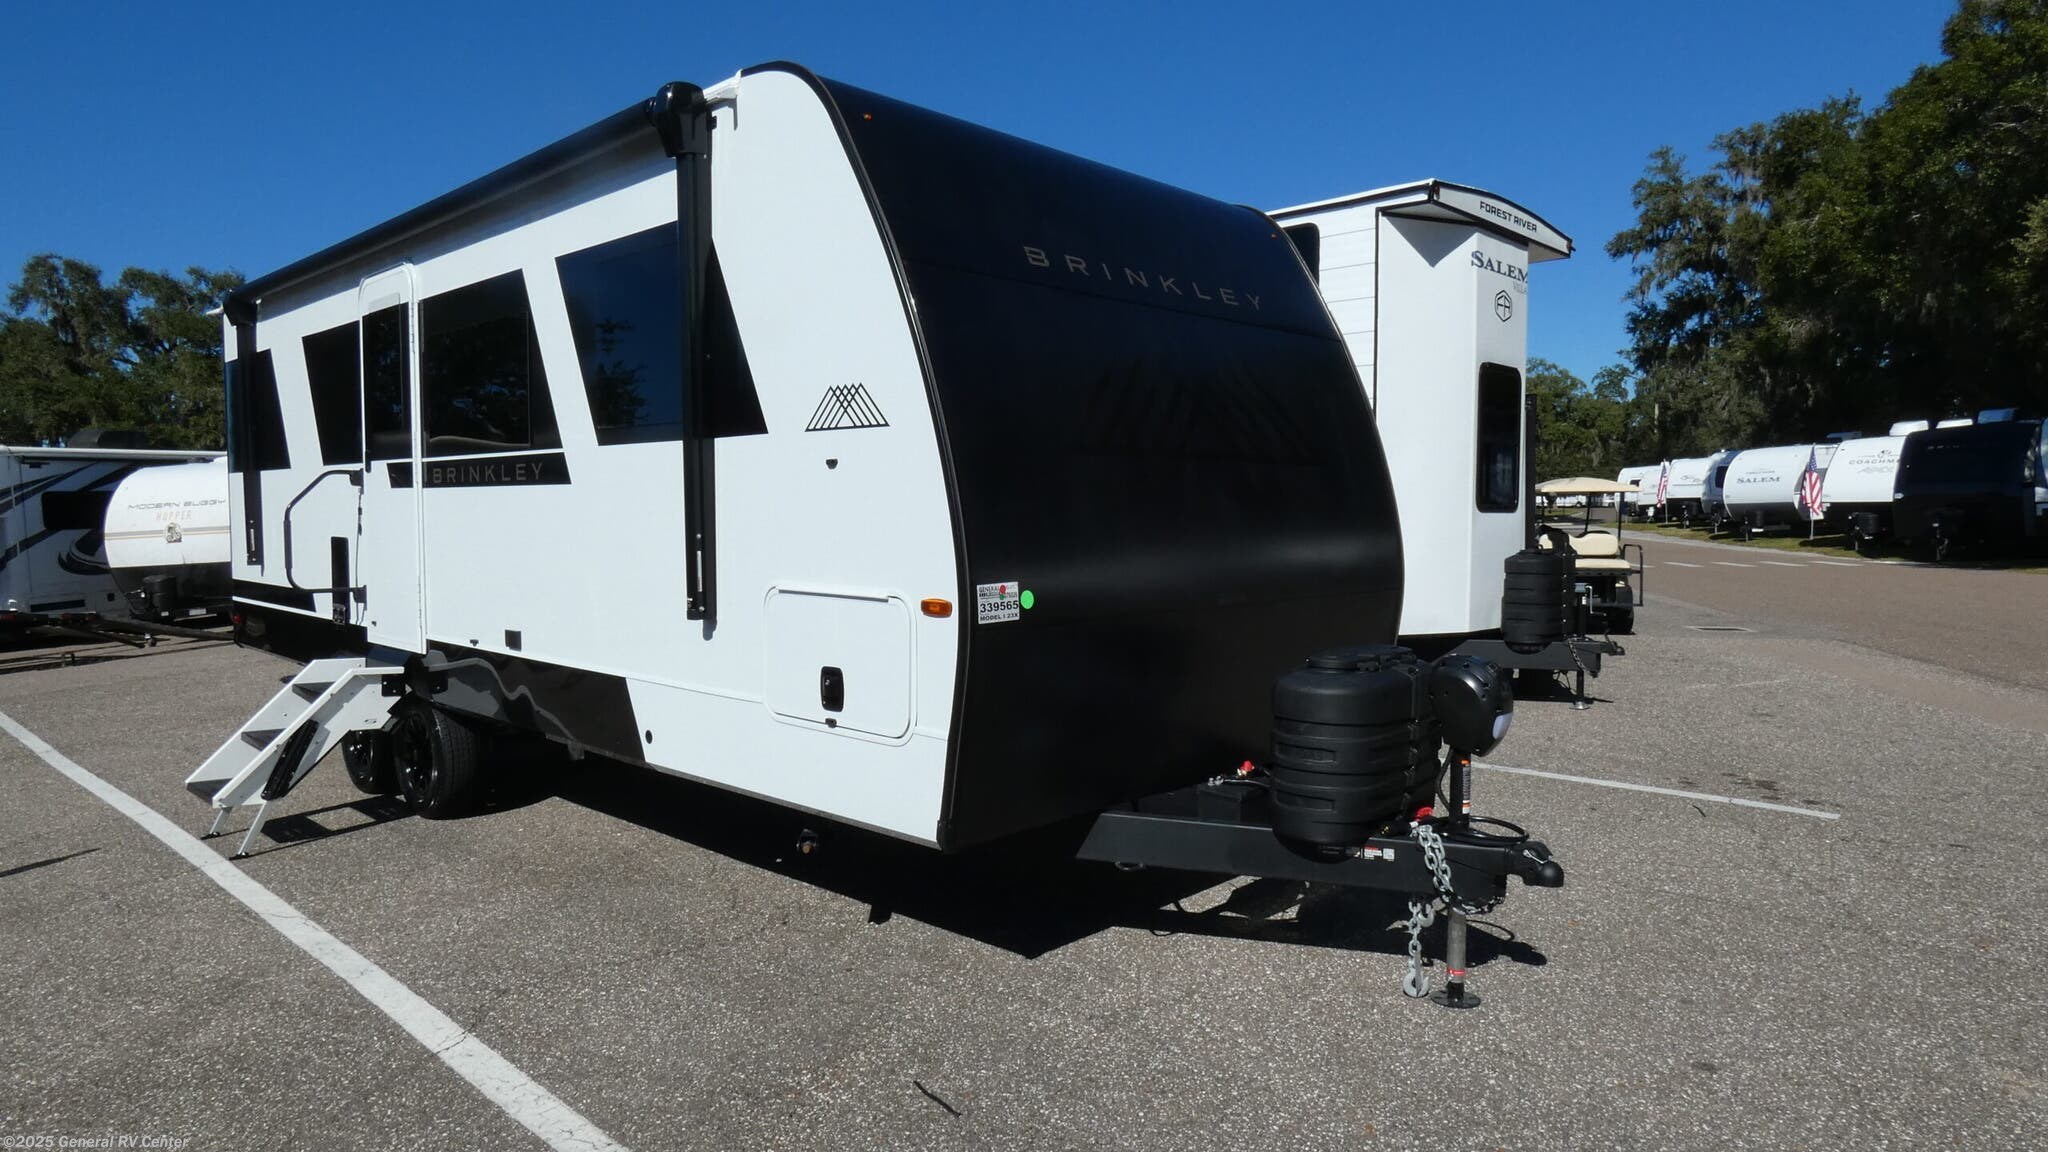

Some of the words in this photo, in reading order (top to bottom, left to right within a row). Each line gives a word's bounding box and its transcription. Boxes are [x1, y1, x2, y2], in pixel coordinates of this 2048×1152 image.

[1480, 201, 1512, 220] FOREST
[1513, 216, 1537, 232] RIVER
[1023, 246, 1263, 311] BRINKLEY
[433, 463, 543, 483] BRINKLEY
[1737, 476, 1780, 484] SALEM
[128, 502, 180, 510] MODERN
[184, 499, 226, 507] BUGGY
[980, 600, 1018, 613] 339565
